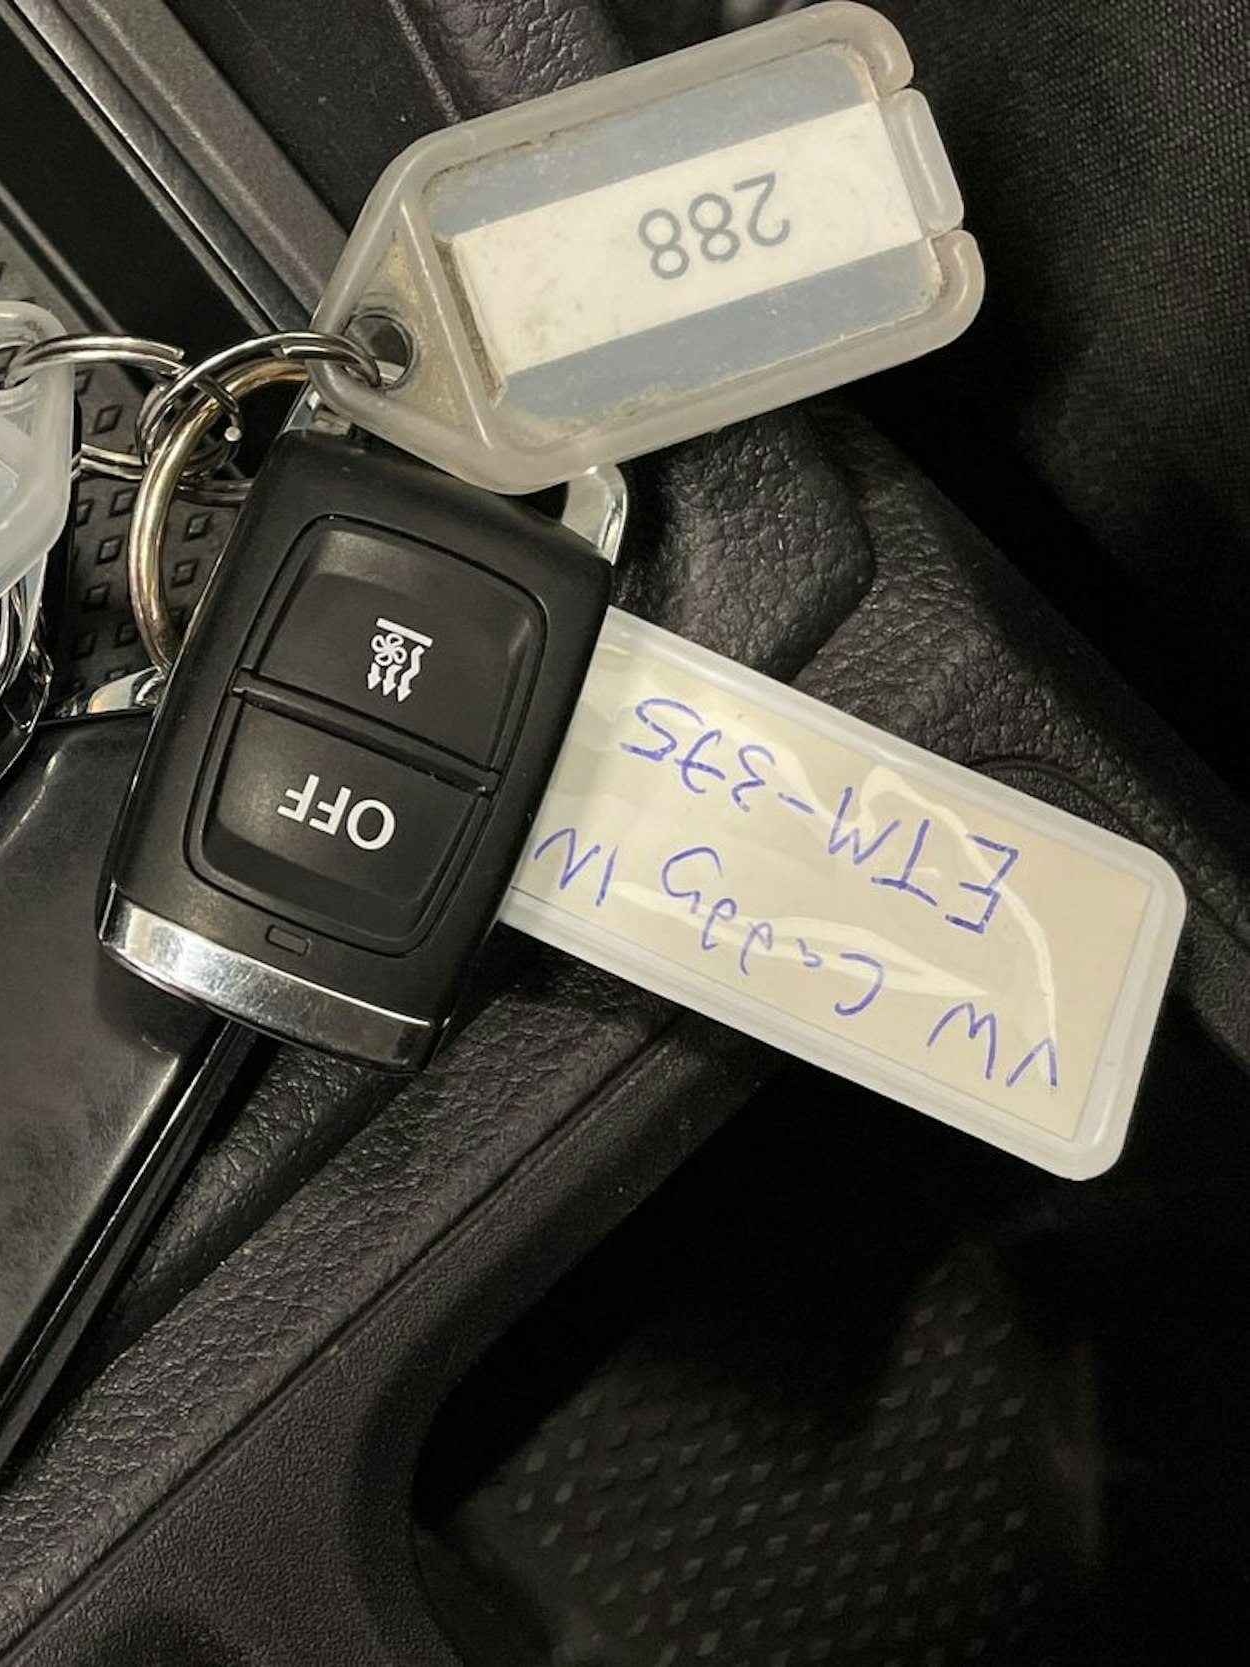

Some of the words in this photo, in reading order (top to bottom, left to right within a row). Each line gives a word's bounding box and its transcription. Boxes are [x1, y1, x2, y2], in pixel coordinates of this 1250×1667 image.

[638, 171, 791, 280] 288
[276, 773, 397, 852] OFF
[618, 696, 1021, 936] ETM-375
[926, 1001, 1058, 1090] VW
